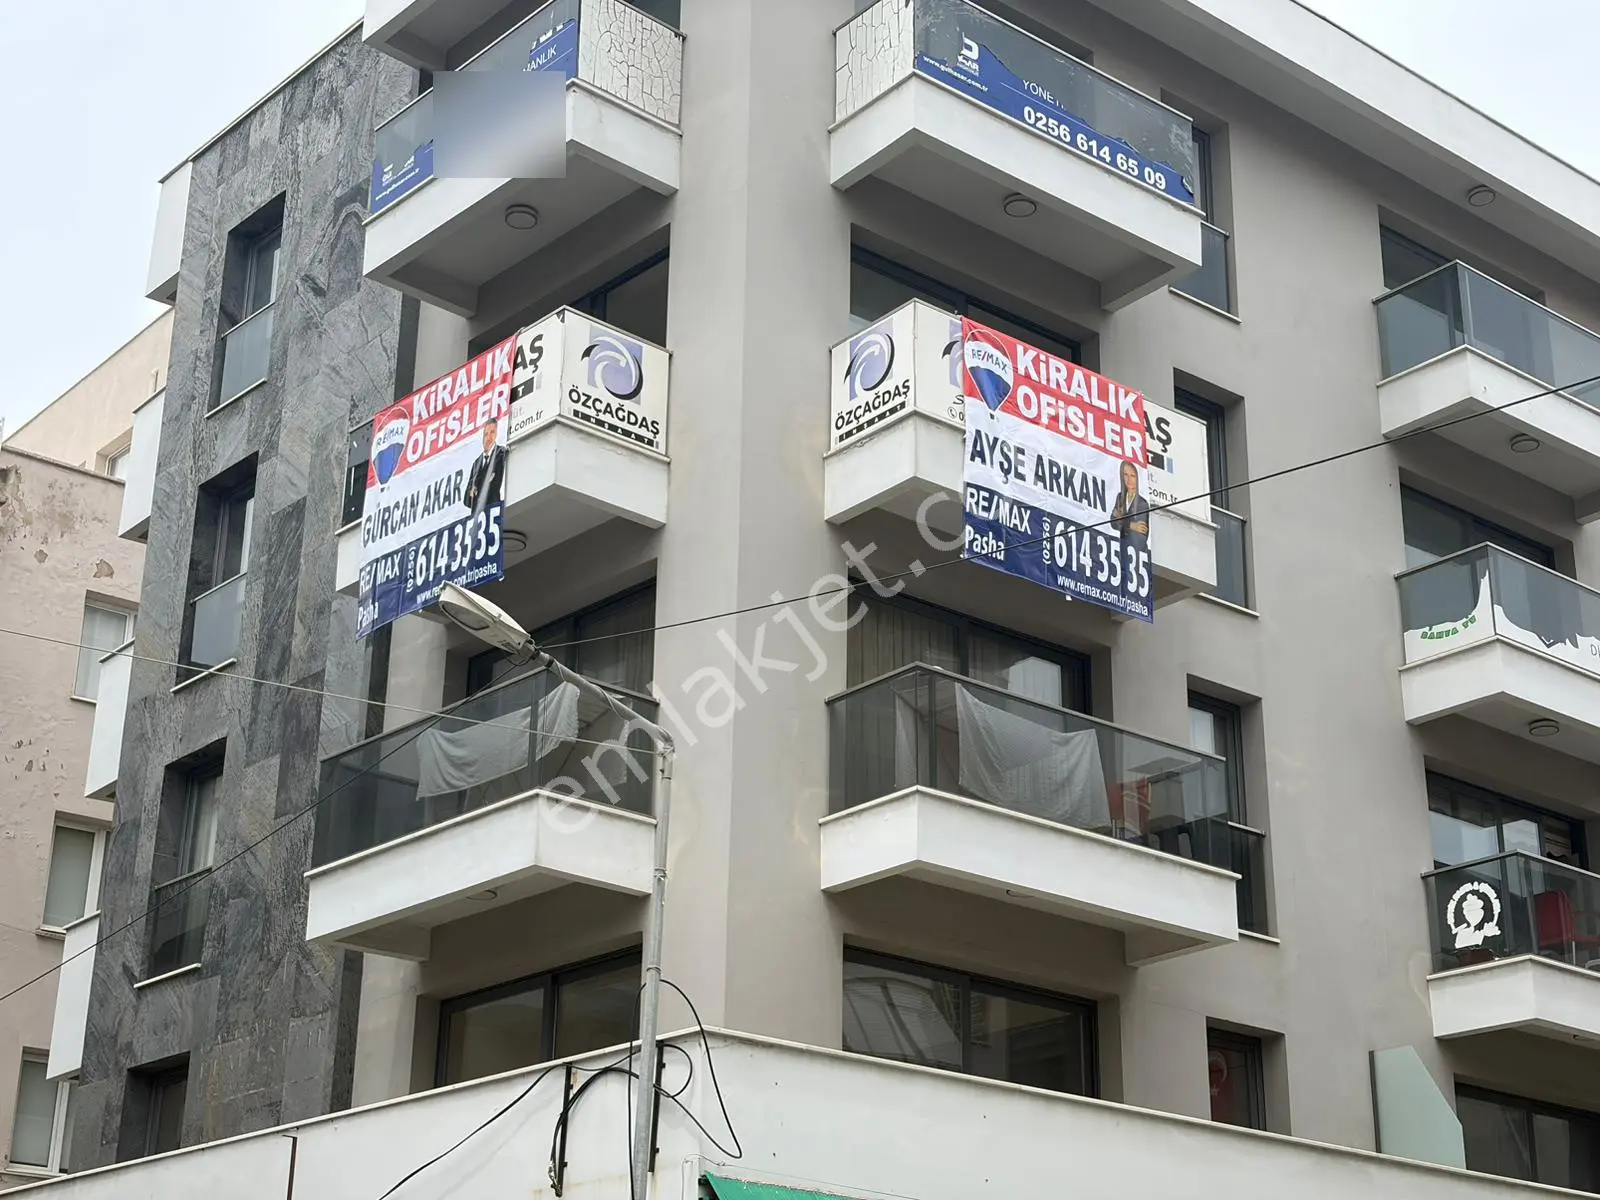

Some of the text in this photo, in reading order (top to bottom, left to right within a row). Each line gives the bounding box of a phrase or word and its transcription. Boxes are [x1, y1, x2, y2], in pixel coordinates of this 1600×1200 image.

[1023, 105, 1166, 190] 0256 614 65 09
[970, 348, 1009, 375] RE/MAX
[568, 384, 660, 440] ÖZÇAĞDAŞ
[835, 379, 910, 430] ÖZÇAĞDAŞ
[421, 469, 464, 519] AKAR
[969, 428, 1107, 513] AYŞE ARKAN
[965, 487, 1032, 536] RE/MAX
[416, 506, 501, 587] 614 35 35
[965, 523, 1005, 561] Pasha
[1054, 520, 1150, 598] 614 35 35
[1056, 573, 1149, 617] www.remax.com.tr/pasha
